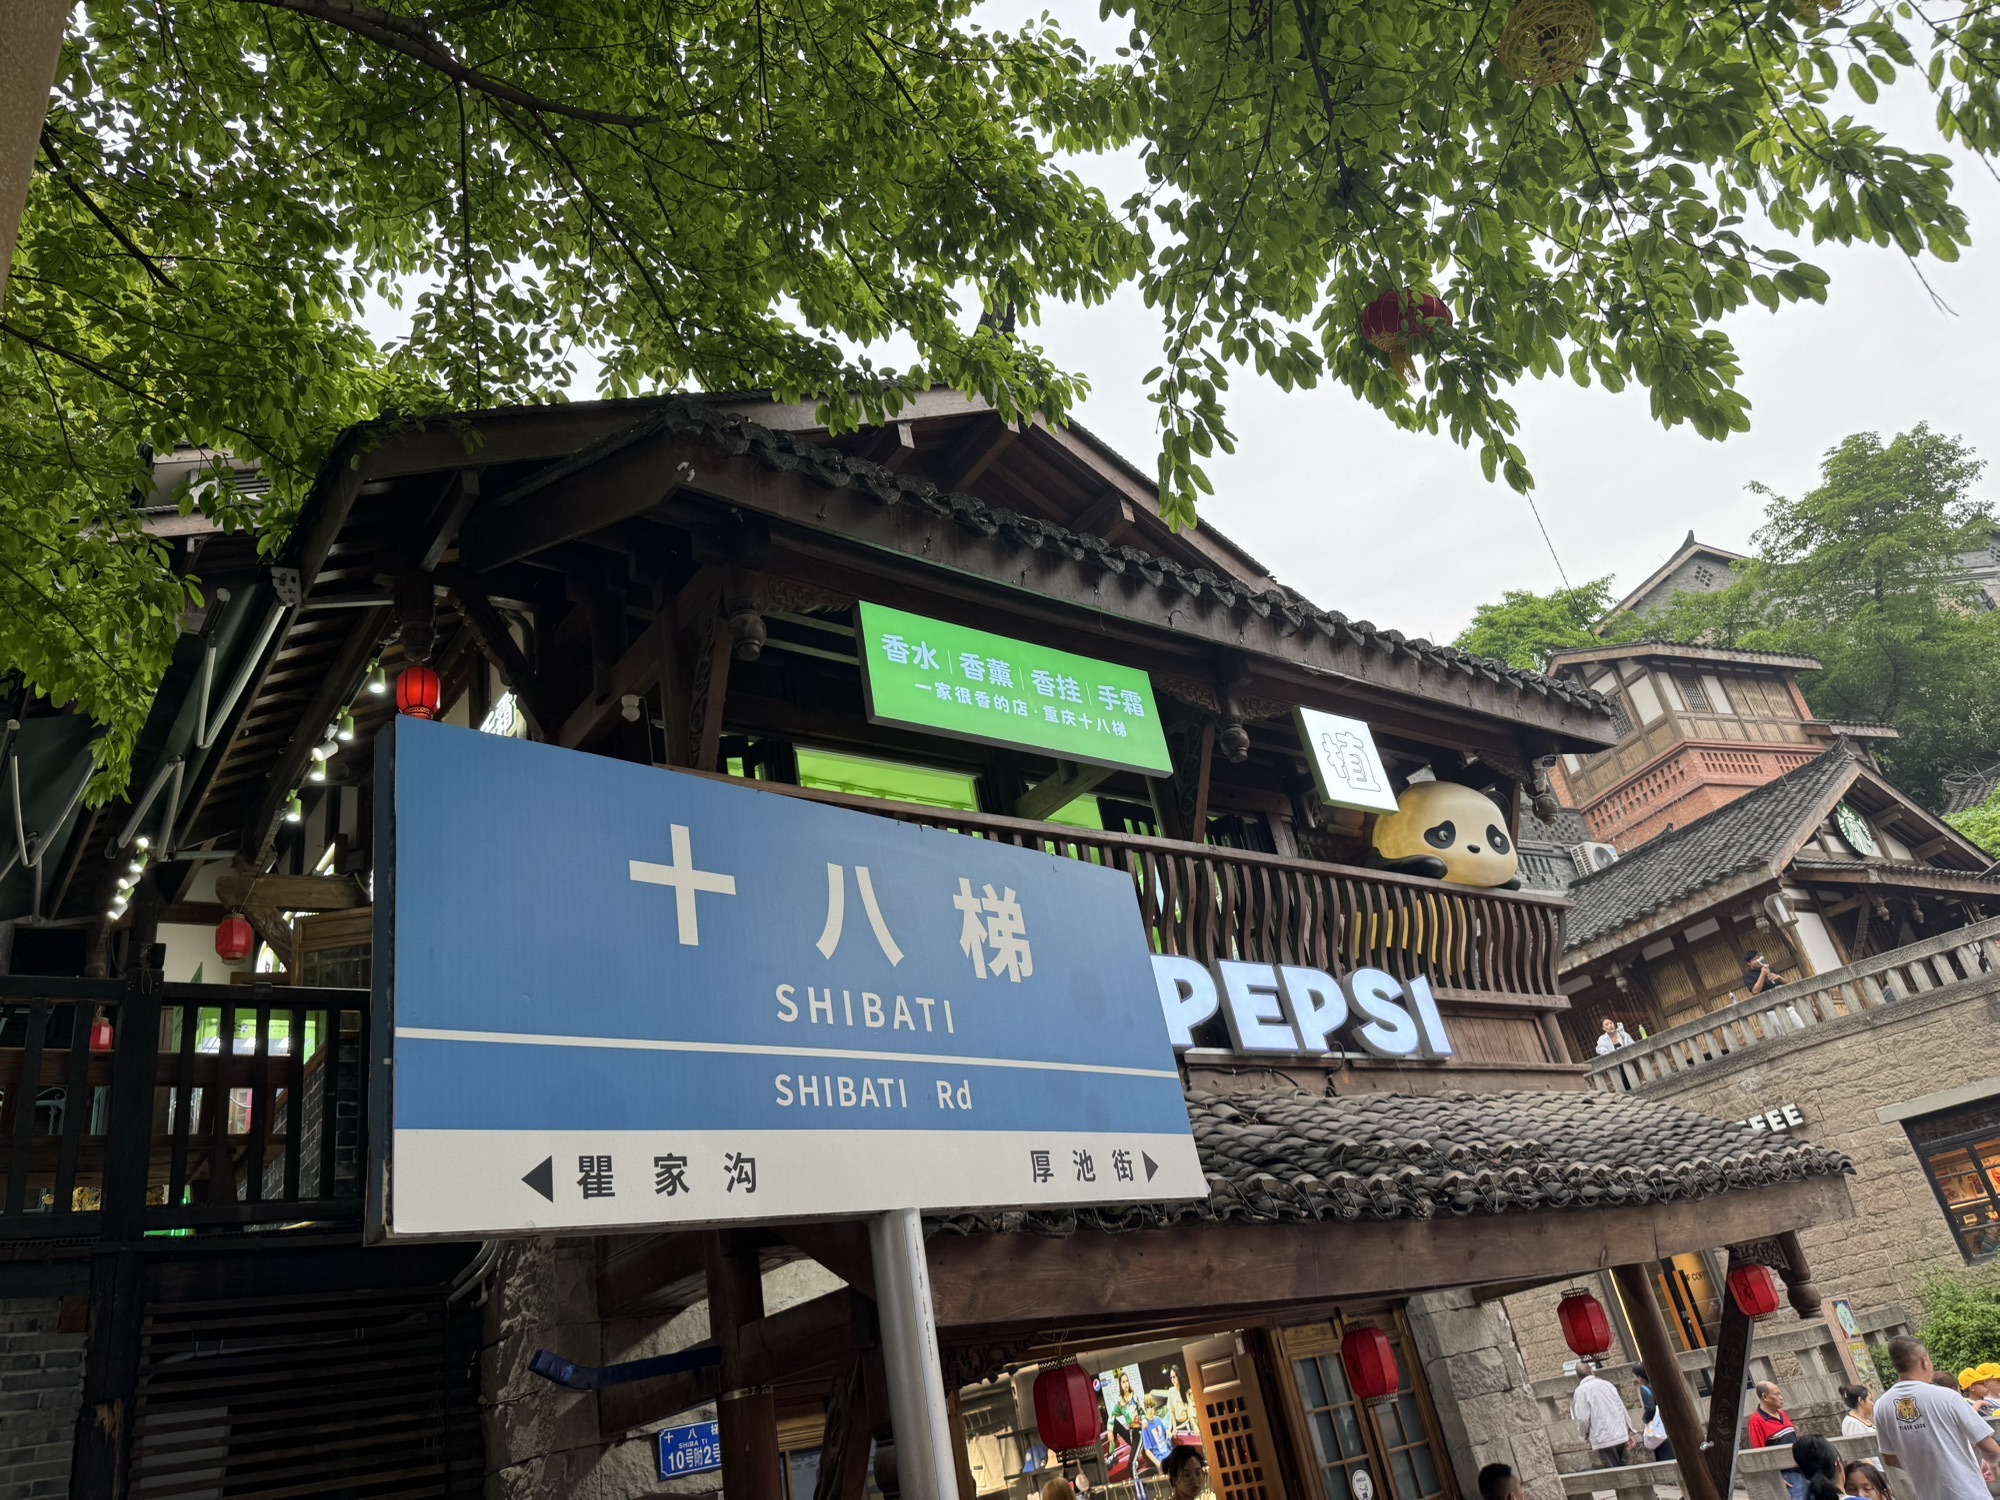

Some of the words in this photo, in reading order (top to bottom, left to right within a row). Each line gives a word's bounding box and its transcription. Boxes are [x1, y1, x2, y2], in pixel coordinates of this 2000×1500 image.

[881, 633, 940, 670] 香水
[1031, 669, 1083, 704] 香挂
[1097, 685, 1145, 717] 手霜
[1321, 731, 1382, 793] 植
[629, 823, 1034, 983] 十八梯
[775, 983, 955, 1034] SHIBATI
[1150, 953, 1454, 1056] PEPSI
[774, 1073, 908, 1109] SHIBATI
[936, 1079, 973, 1110] Rd
[1734, 1102, 1804, 1133] FEE
[576, 1151, 757, 1200] 瞿家沟
[1030, 1149, 1134, 1184] 厚池街
[668, 1443, 720, 1470] 10号附2号
[678, 1440, 699, 1449] SHIBA
